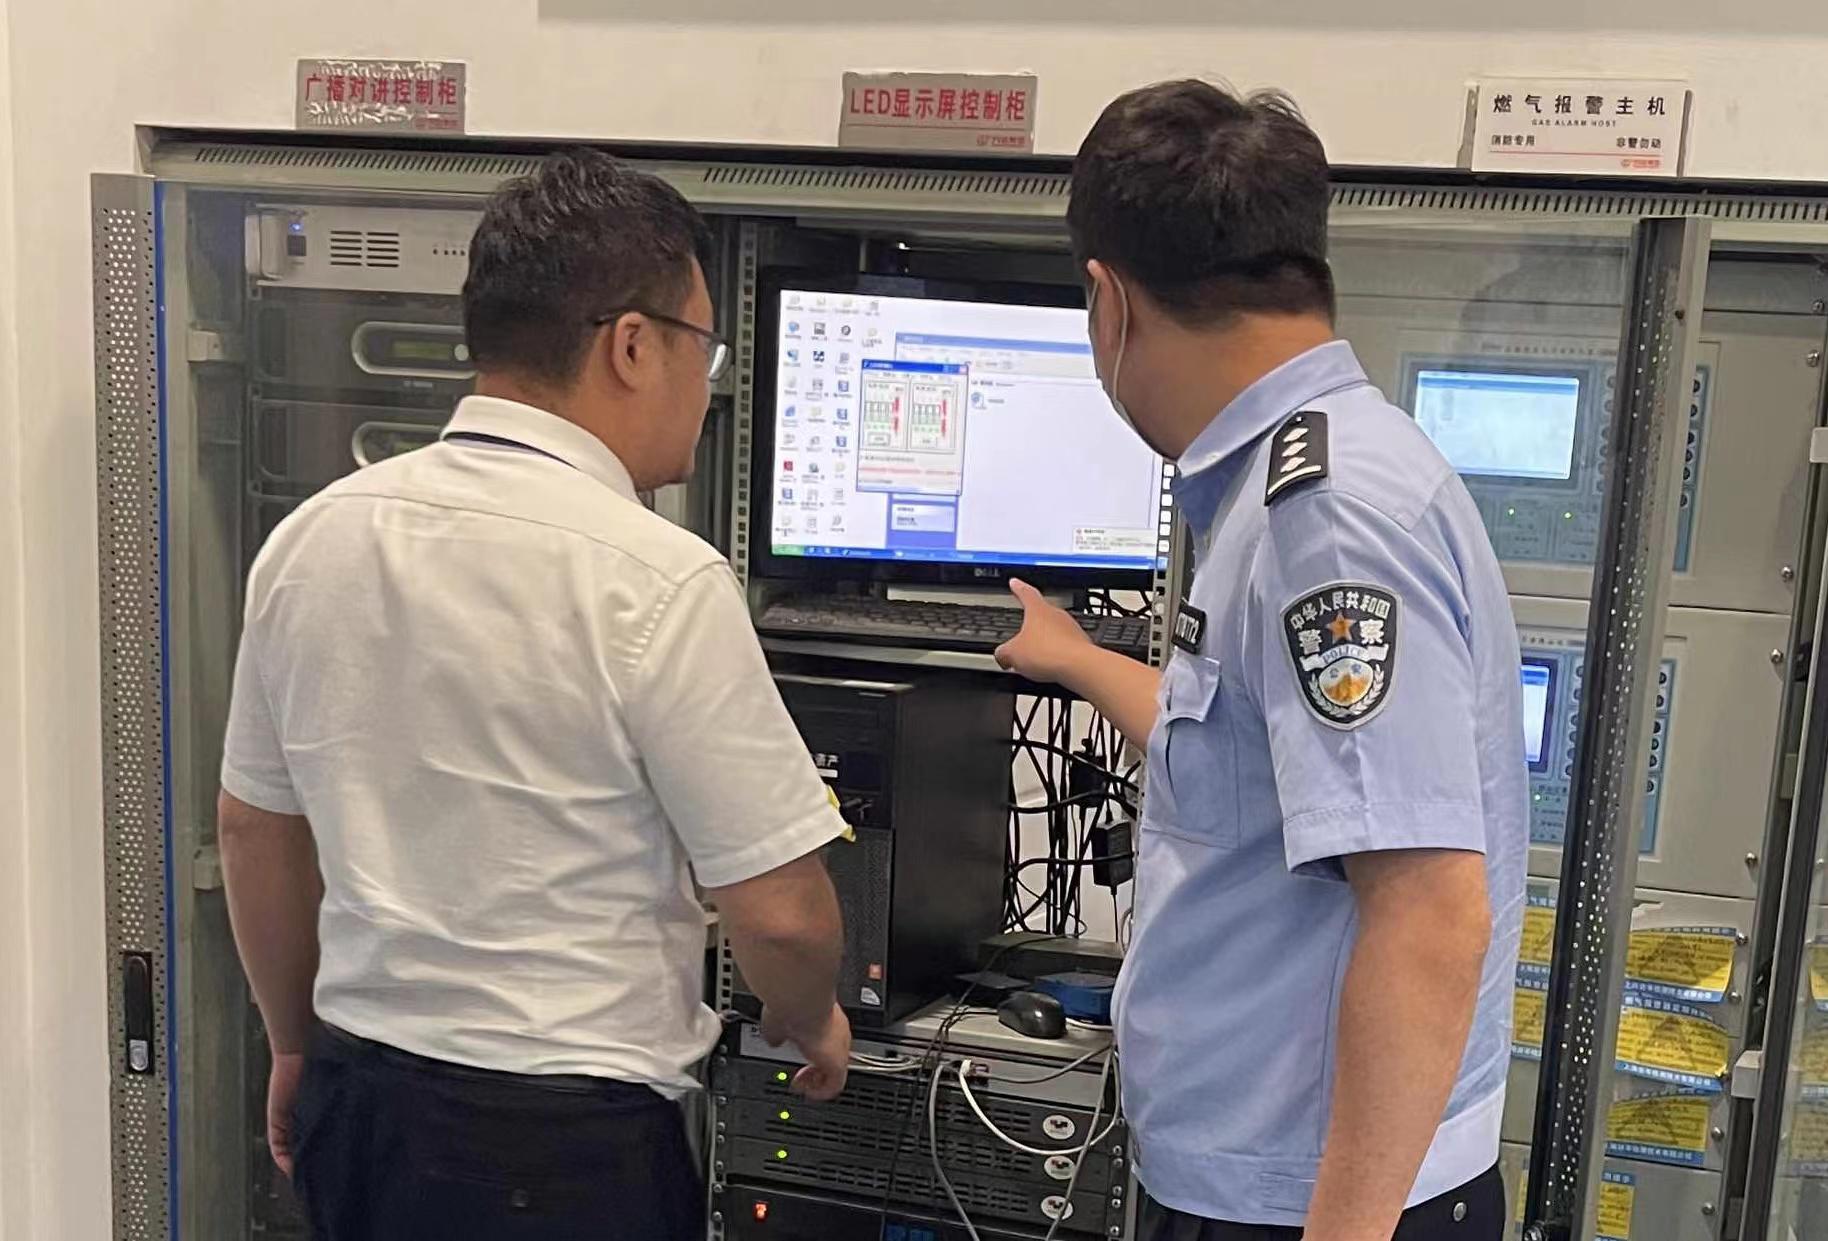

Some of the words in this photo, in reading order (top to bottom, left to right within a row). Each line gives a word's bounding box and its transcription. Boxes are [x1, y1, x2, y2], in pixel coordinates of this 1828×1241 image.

[304, 72, 458, 106] 广播对讲控制柜
[849, 87, 1026, 122] LED显示屏控制柜
[1492, 94, 1666, 116] 燃气报警主机
[1531, 118, 1551, 127] GAS
[1554, 119, 1588, 127] ALARM
[1491, 134, 1536, 146] 消防专用
[1290, 590, 1391, 631] 中华人民共和国
